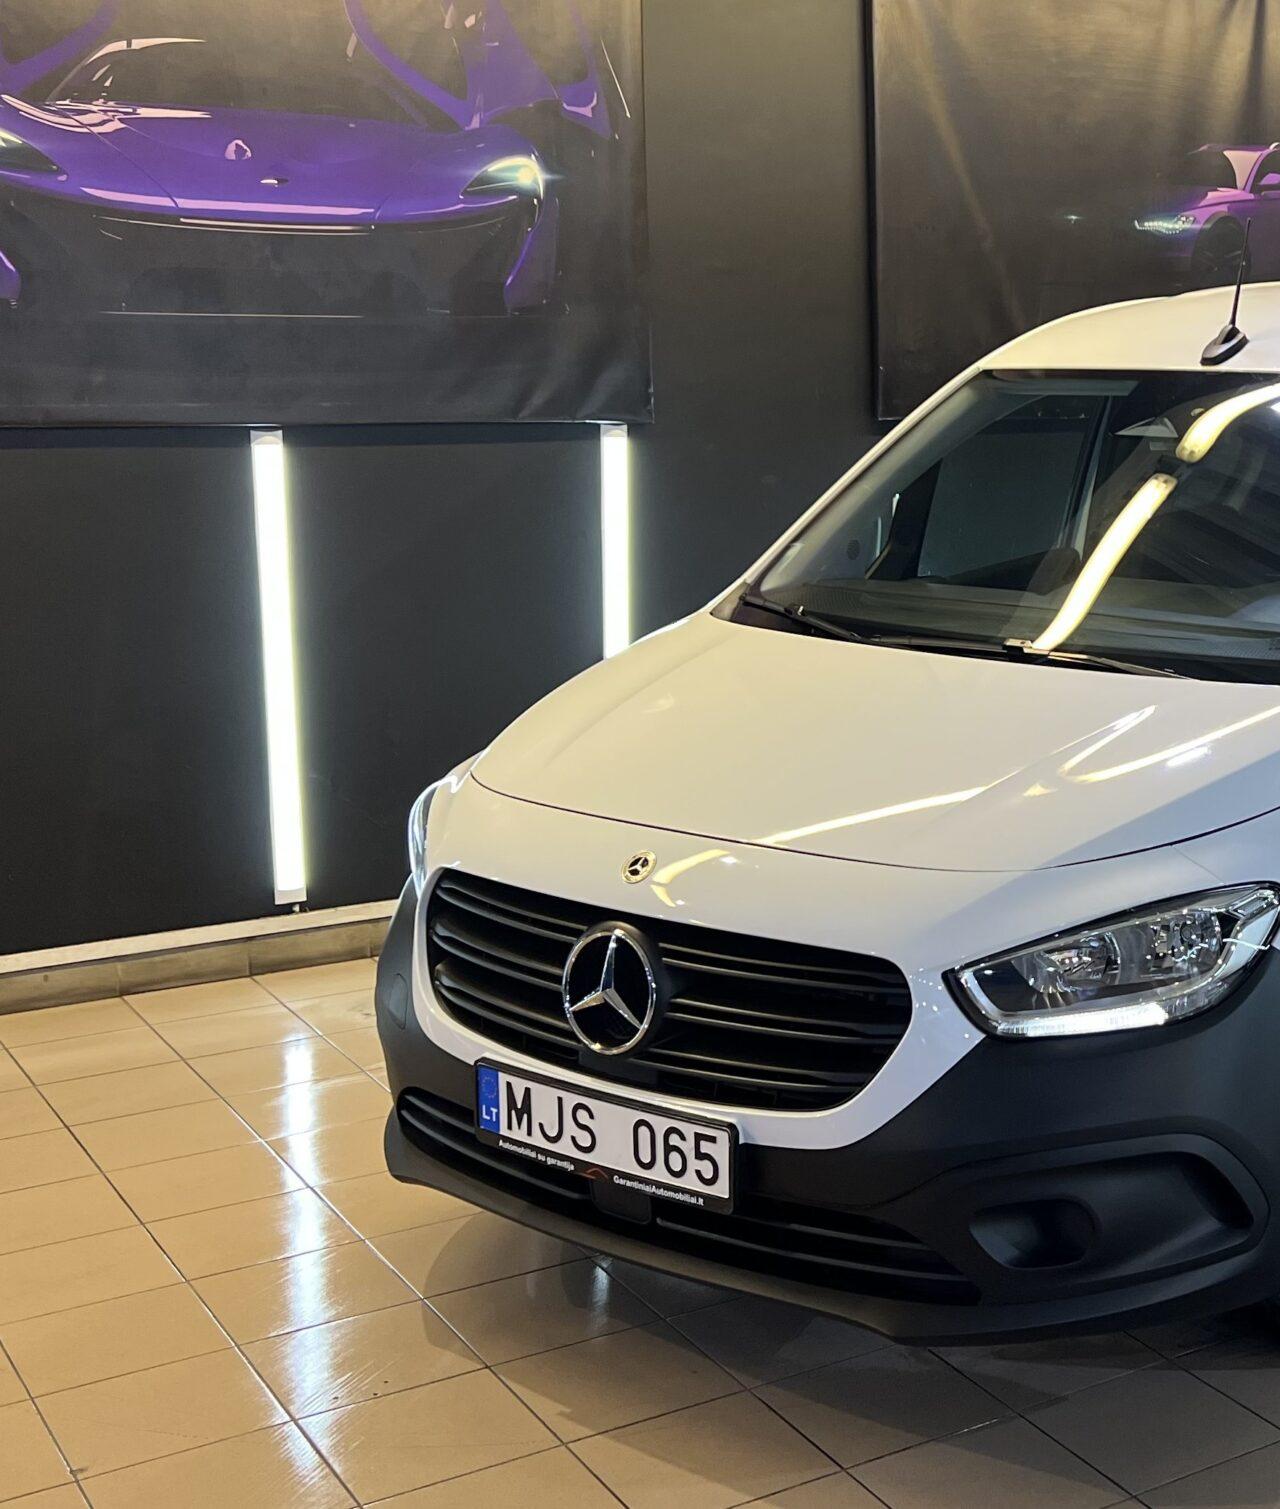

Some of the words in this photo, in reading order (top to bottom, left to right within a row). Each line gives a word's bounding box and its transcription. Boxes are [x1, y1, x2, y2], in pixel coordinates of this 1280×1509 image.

[482, 1104, 498, 1122] LT
[505, 1080, 597, 1154] MJS
[632, 1118, 720, 1187] 065
